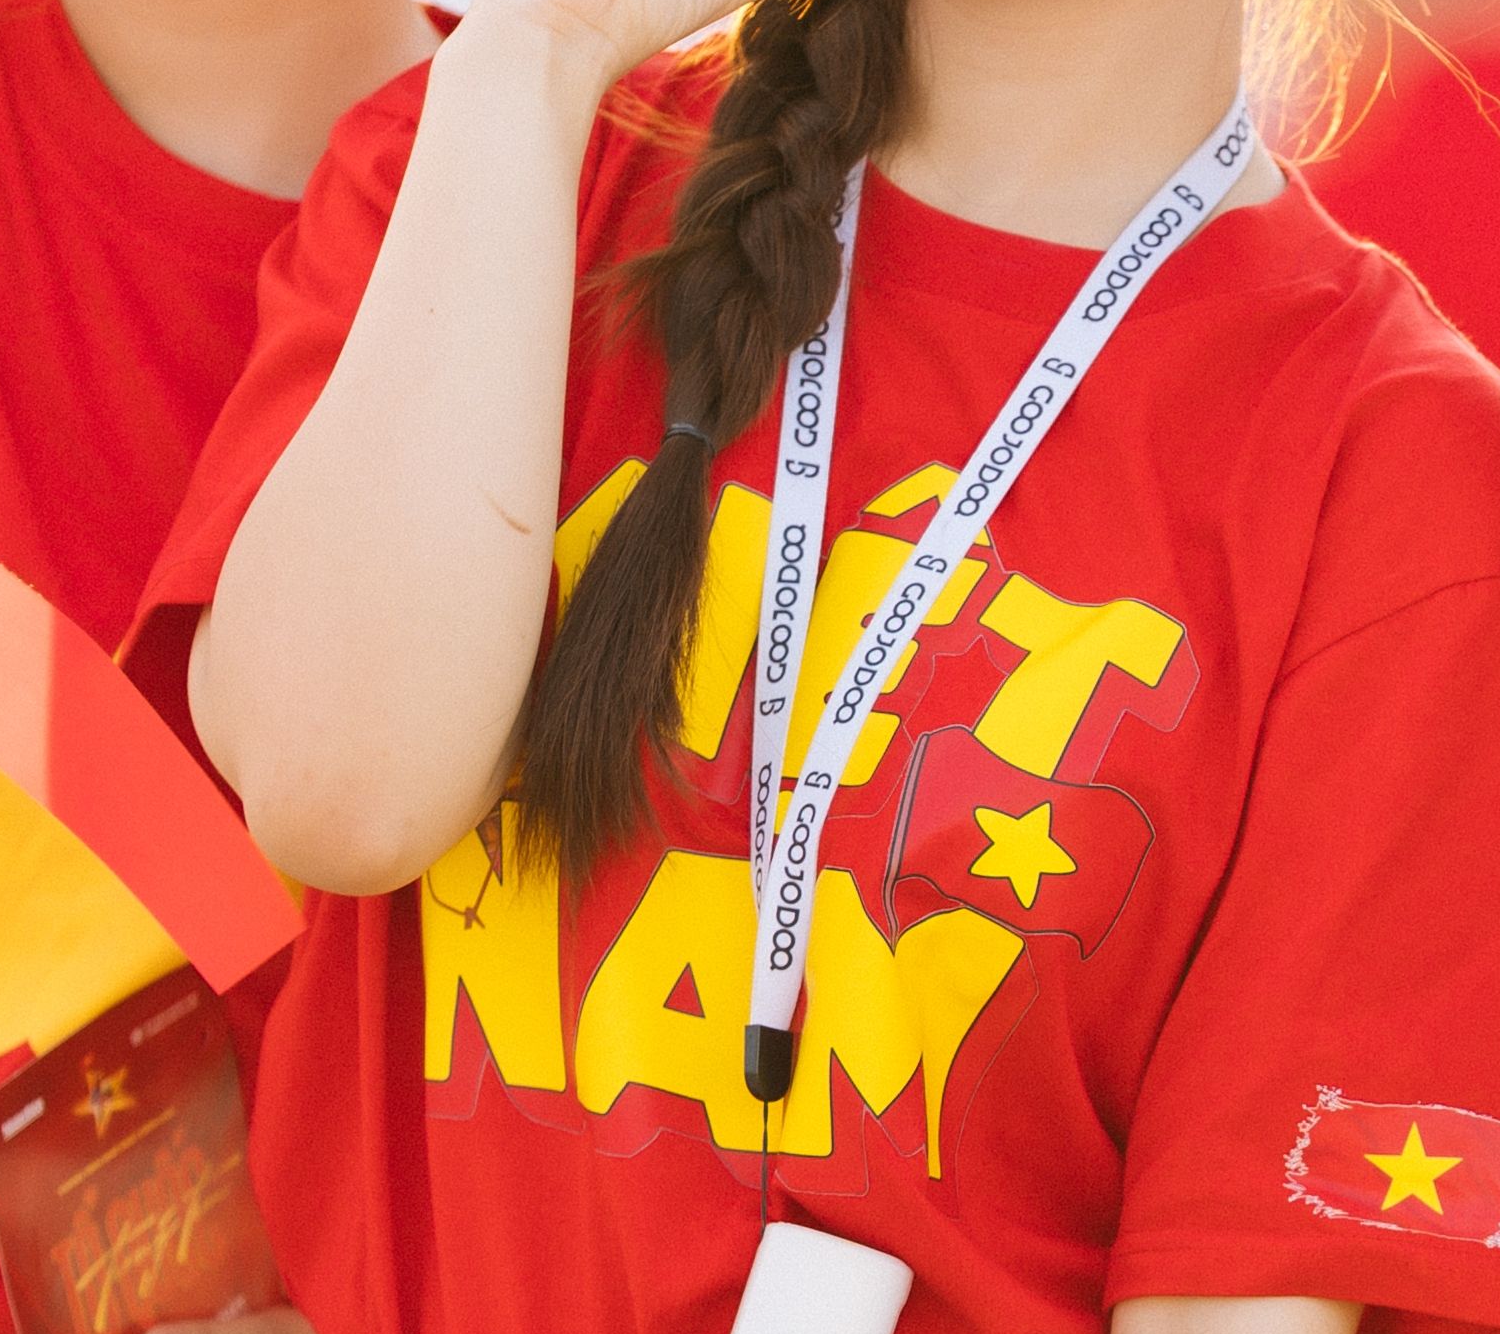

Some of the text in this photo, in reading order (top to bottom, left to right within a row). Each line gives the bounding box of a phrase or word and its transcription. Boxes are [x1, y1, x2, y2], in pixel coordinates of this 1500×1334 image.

[1082, 207, 1183, 322] GOOJODOQ
[953, 384, 1054, 517] GOOJODOQ
[766, 524, 806, 684] GOOJODOQ
[833, 581, 926, 725] GOOJODOQ
[769, 802, 817, 971] GOOJODOQ
[422, 800, 1026, 1180] NAM
